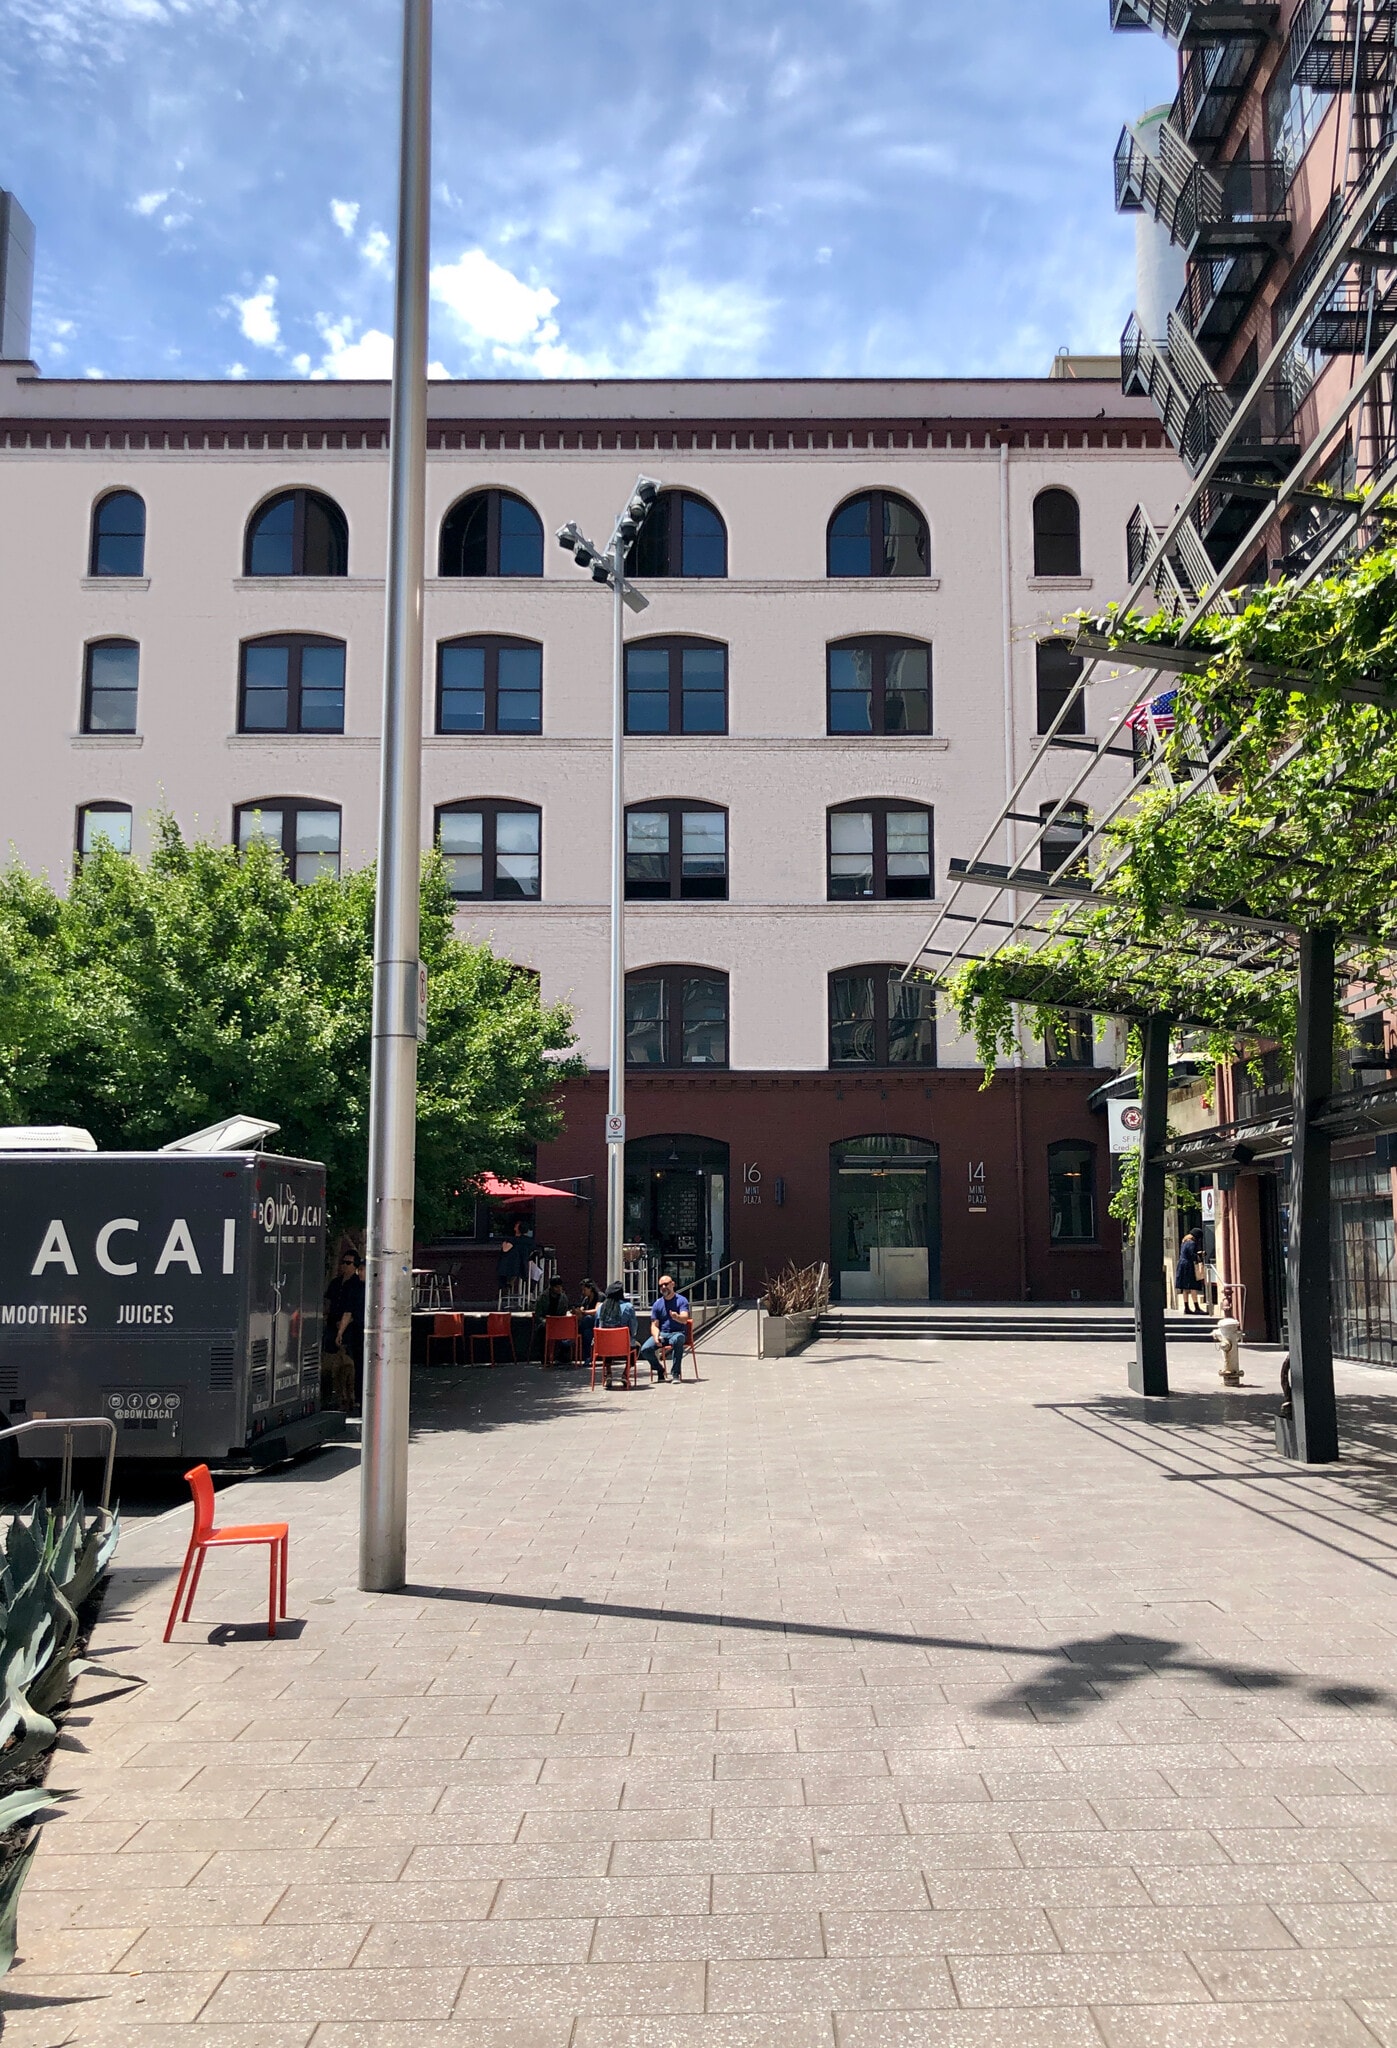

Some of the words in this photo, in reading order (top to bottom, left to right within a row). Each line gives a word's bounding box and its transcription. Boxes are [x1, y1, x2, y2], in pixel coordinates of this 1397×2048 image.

[743, 1162, 761, 1183] 16
[968, 1161, 986, 1183] 14
[743, 1195, 762, 1205] PLAZA
[967, 1194, 987, 1204] PLAZA
[969, 1185, 985, 1194] MINT
[301, 1205, 322, 1227] ACAI
[31, 1217, 236, 1276] ACAI
[0, 1304, 88, 1325] MOOTHIES
[116, 1304, 175, 1325] JUICES
[114, 1409, 174, 1419] @BOWLDACAI
